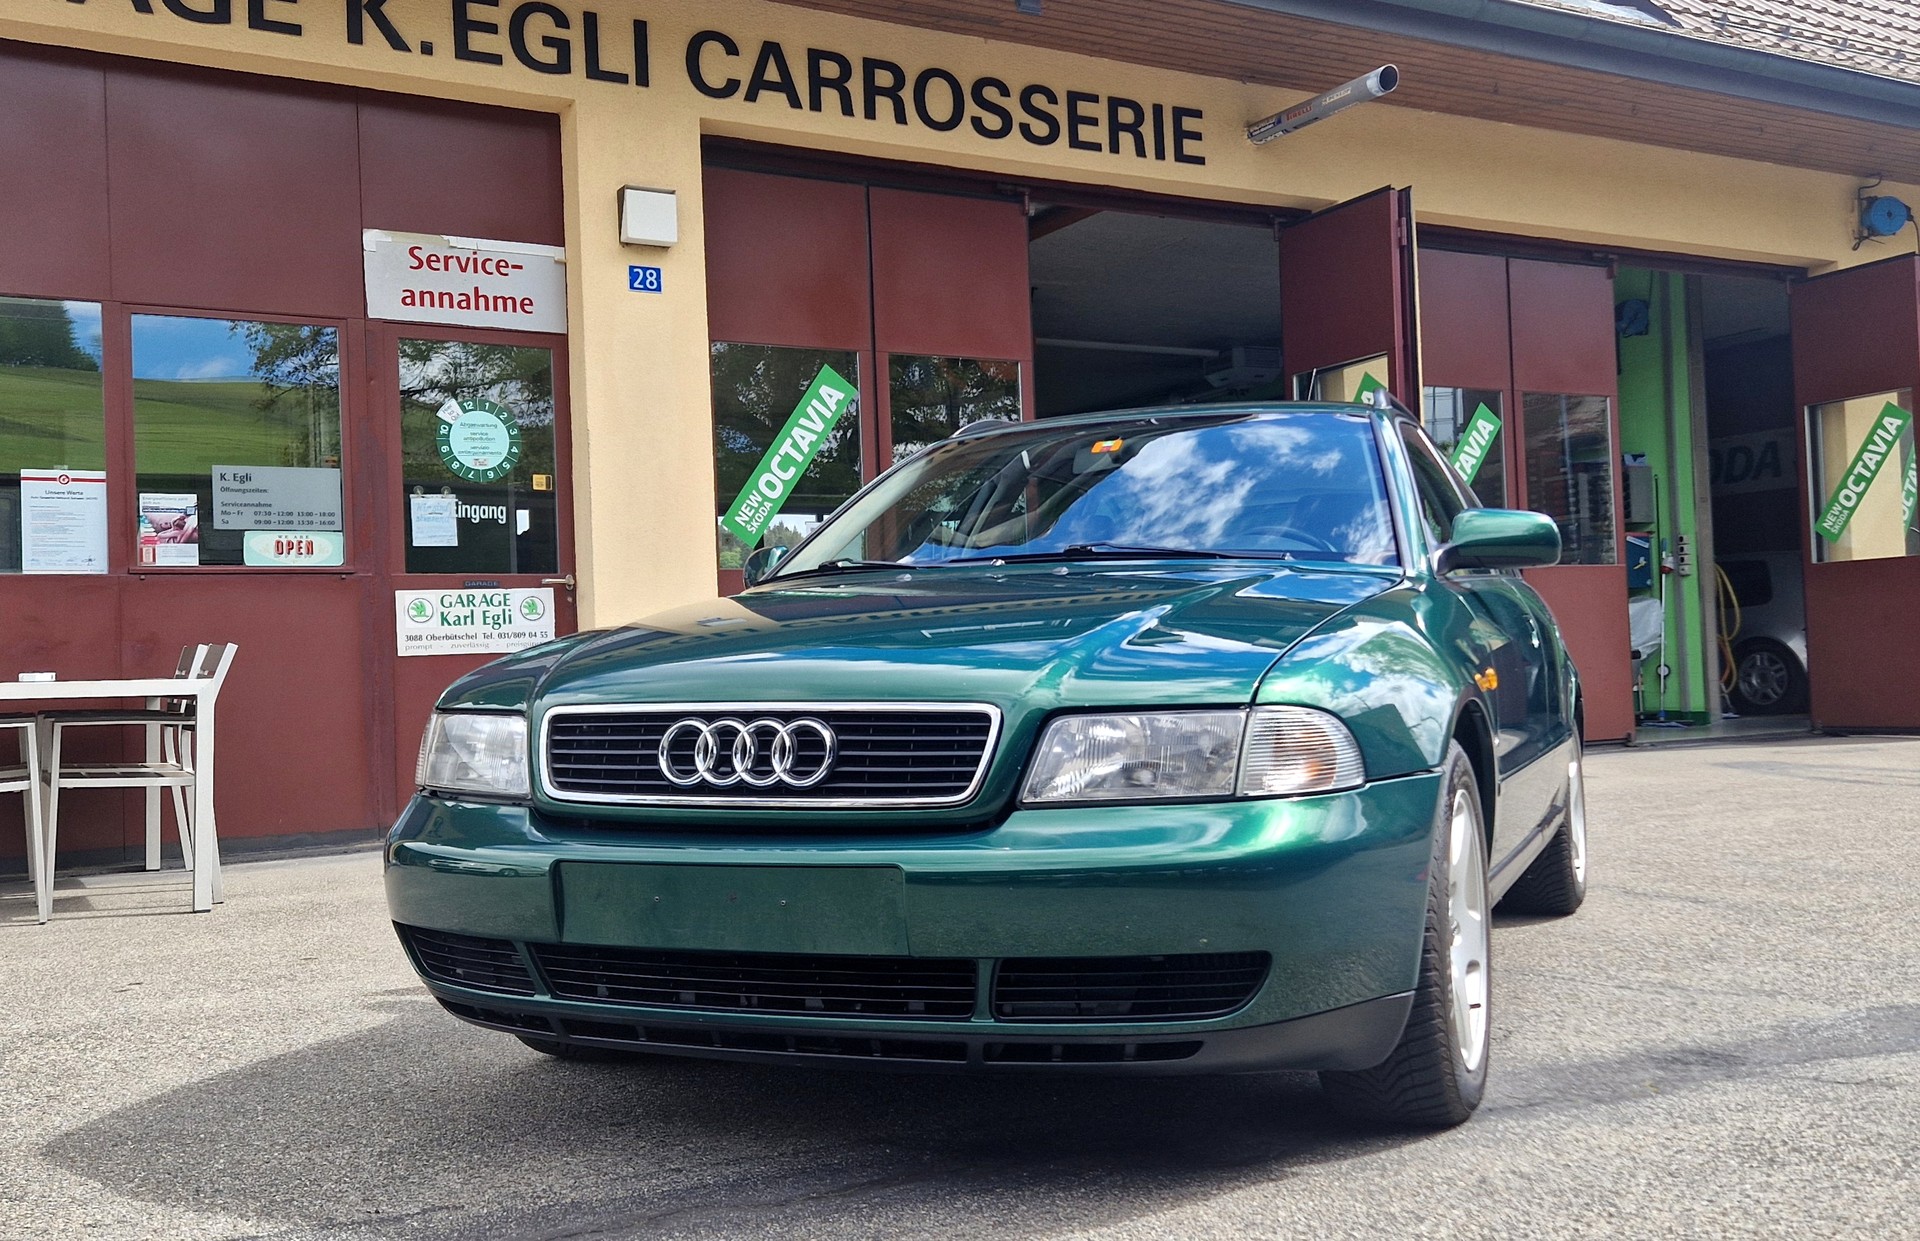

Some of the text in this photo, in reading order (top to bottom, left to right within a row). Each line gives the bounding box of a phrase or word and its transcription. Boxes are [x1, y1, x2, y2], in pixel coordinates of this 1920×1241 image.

[685, 30, 1207, 166] CARROSSERIE
[1285, 105, 1313, 121] PIRELLI
[407, 245, 524, 277] Service-
[632, 267, 658, 290] 28
[400, 286, 534, 315] annahme
[463, 401, 475, 410] 12
[484, 402, 490, 410] 1
[500, 412, 508, 420] 2
[440, 424, 448, 435] 10
[757, 384, 845, 500] OCTAVIA
[510, 446, 518, 454] 4
[451, 461, 460, 469] 8
[1838, 416, 1904, 508] OCTAVIA
[220, 473, 252, 484] K. Egli
[468, 470, 474, 479] 7
[487, 471, 494, 479] 6
[734, 490, 763, 527] NEW
[1822, 502, 1842, 530] NEW
[274, 540, 314, 556] OPEN
[440, 593, 511, 608] GARAGE
[440, 608, 512, 630] Karl Egli
[426, 632, 477, 641] Oberbütschel
[498, 632, 526, 640] 031/809
